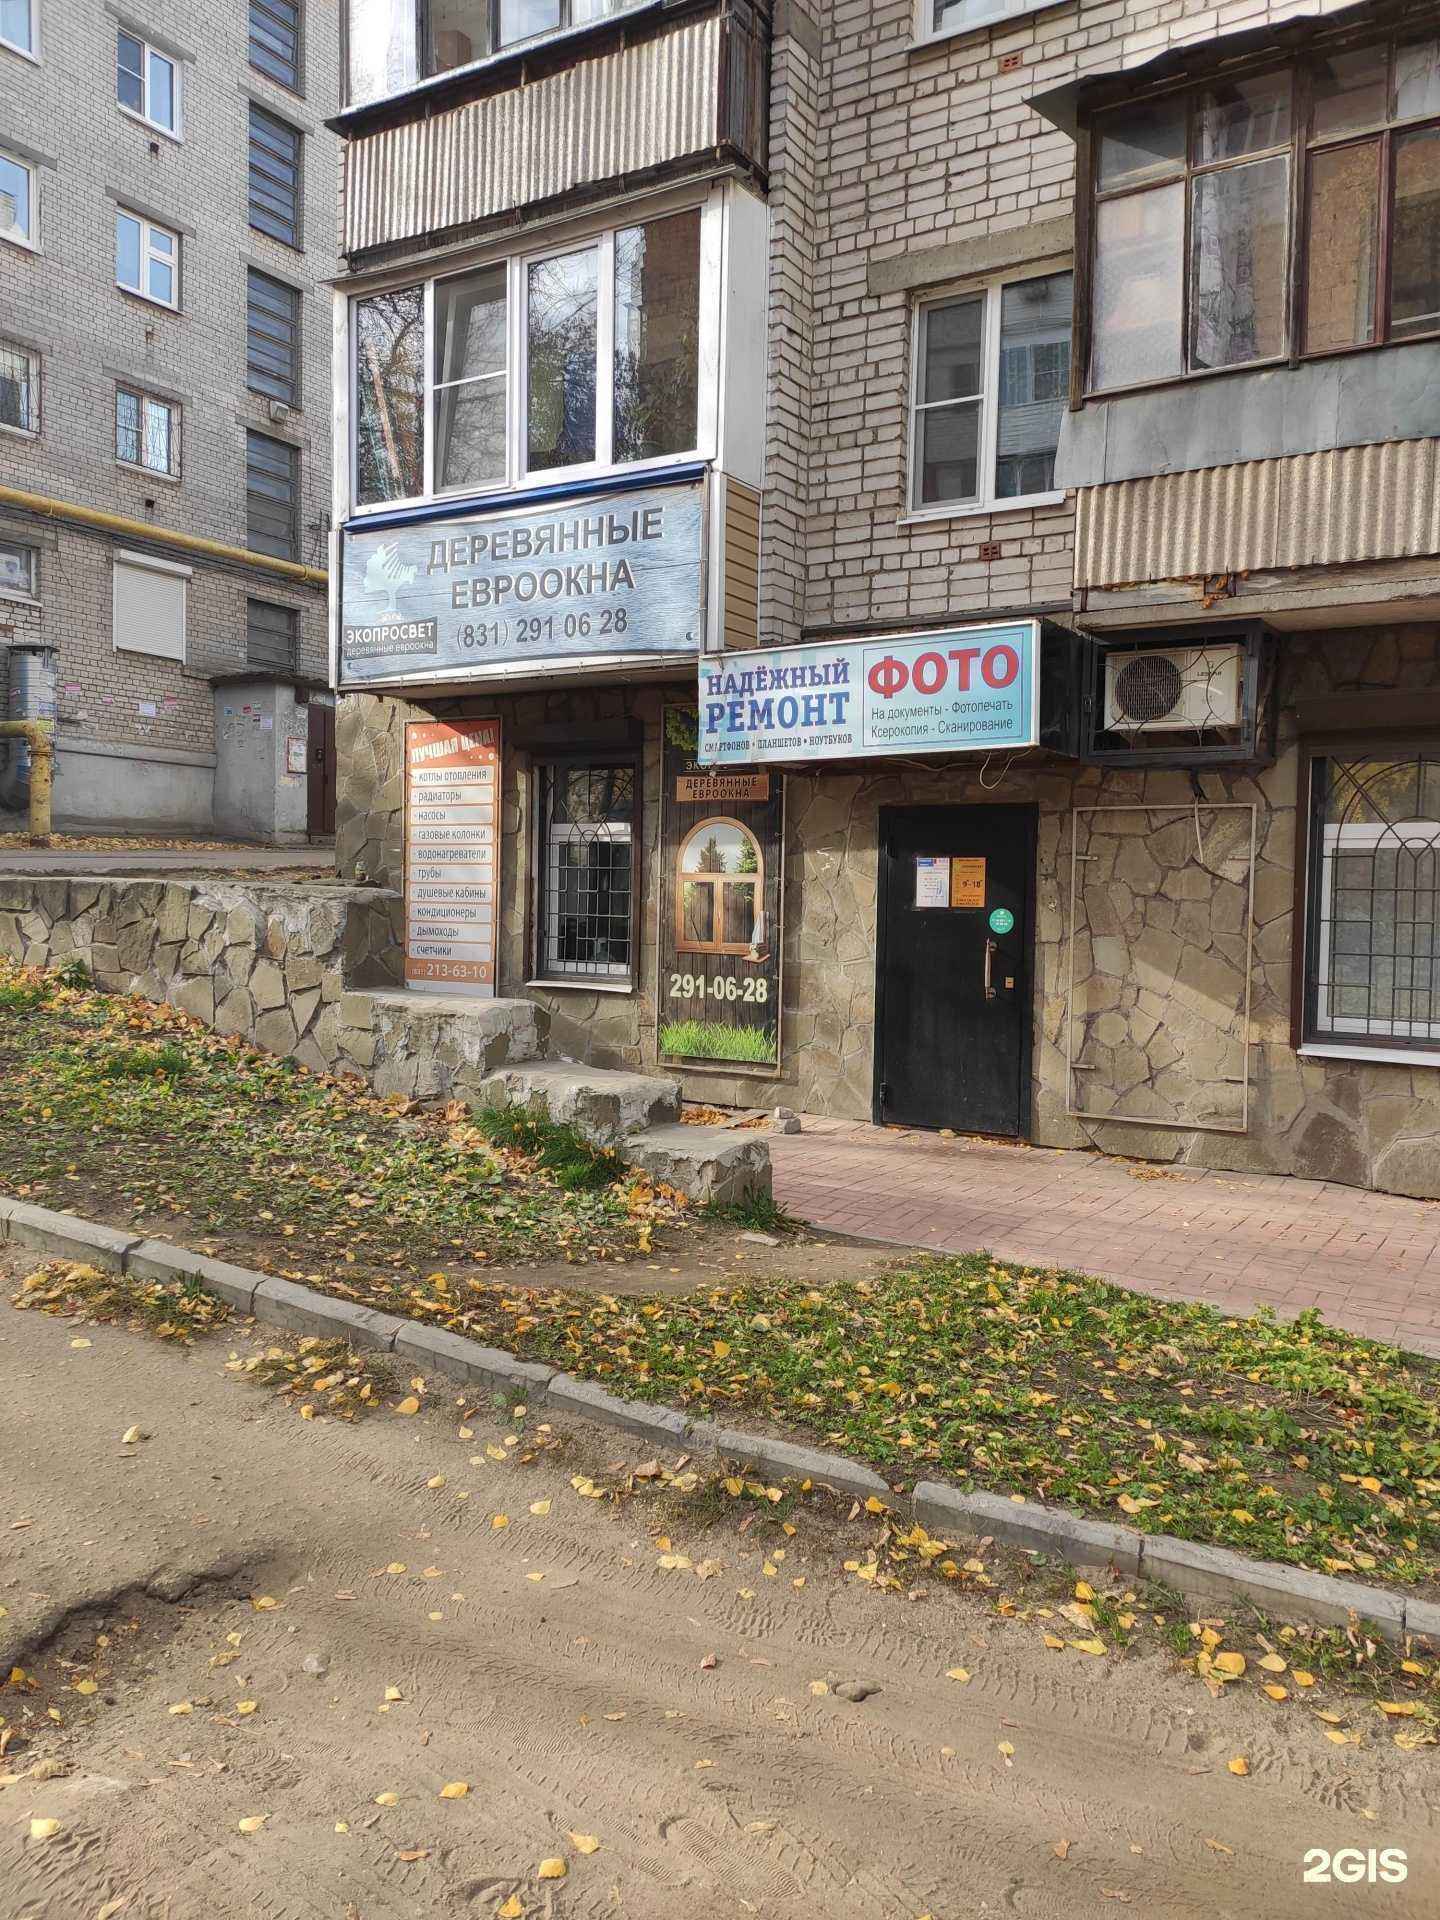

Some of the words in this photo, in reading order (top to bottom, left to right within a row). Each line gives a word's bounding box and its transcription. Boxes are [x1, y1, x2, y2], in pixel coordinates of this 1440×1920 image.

[427, 507, 663, 575] ДЕРЕВЯННЫЕ
[450, 558, 636, 610] ЕВРООКНА
[345, 621, 434, 644] ЭКОПРОСВЕТ
[456, 619, 511, 650] (831)
[516, 612, 556, 643] 291
[563, 612, 592, 637] 06
[600, 606, 629, 635] 28
[706, 659, 850, 697] НАДЁЖНЫЙ
[867, 644, 1020, 699] ФОТО
[705, 691, 851, 735] РЕМОНТ
[871, 707, 885, 720] На
[887, 705, 942, 721] документы
[952, 700, 1013, 714] Фотопечать
[871, 724, 929, 739] Ксерокопия
[938, 718, 1013, 734] Сканирование
[757, 736, 801, 750] ПЛАНШЕТОВ
[809, 733, 853, 747] НОУТБУКОВ
[686, 776, 757, 790] ДЕРЕВЯННЫЕ
[418, 791, 462, 804] радиаторы
[692, 788, 750, 799] ЕВРООКНА
[418, 810, 446, 820] насосы
[418, 830, 450, 841] газовые
[452, 828, 486, 840] колонки
[418, 848, 486, 861] водонагреватели
[418, 866, 442, 878] трубы
[417, 887, 453, 901] душевые
[455, 886, 486, 898] кабины
[417, 908, 477, 920] кондиционеры
[416, 946, 452, 956] счетчики
[426, 963, 487, 978] 213-63-10
[669, 972, 768, 1004] 291-06-28
